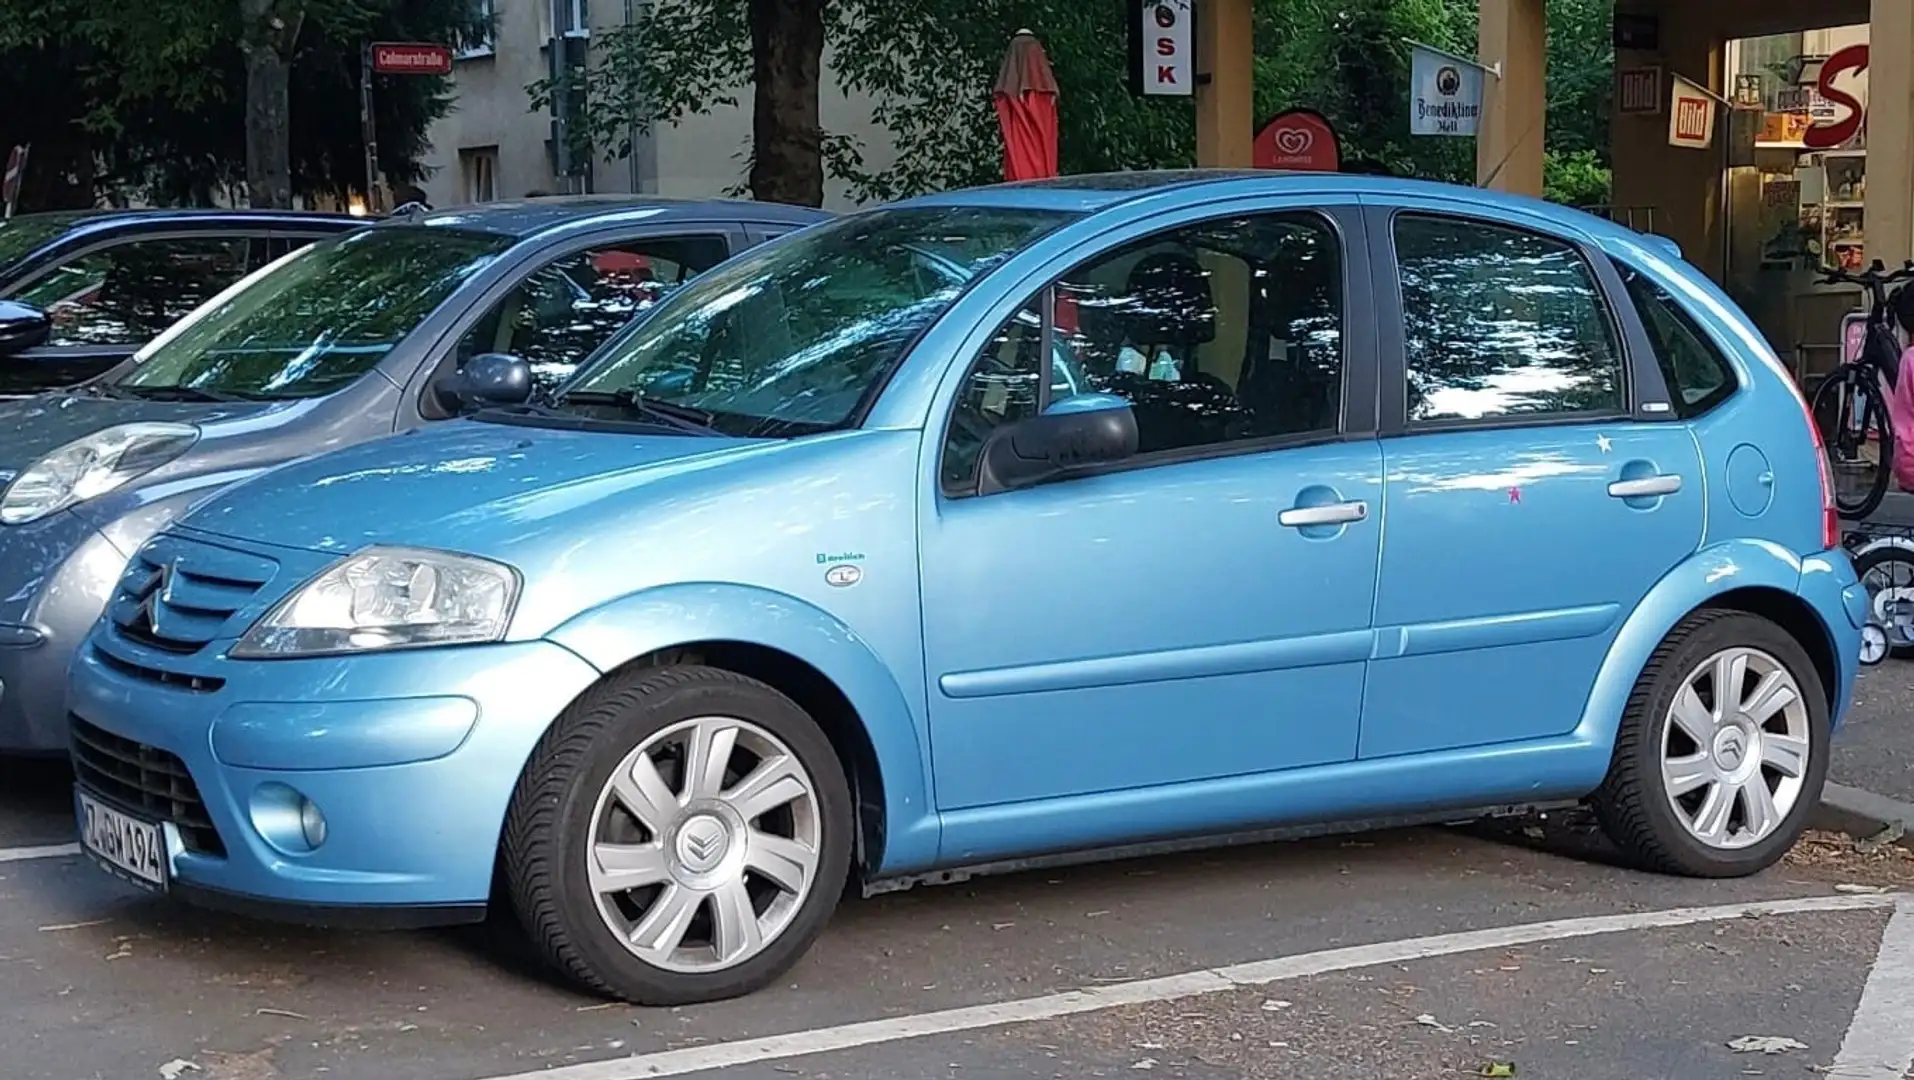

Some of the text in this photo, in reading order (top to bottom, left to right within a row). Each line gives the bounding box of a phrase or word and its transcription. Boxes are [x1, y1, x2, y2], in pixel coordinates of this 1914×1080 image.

[1623, 72, 1654, 109] Bild
[1678, 101, 1706, 136] Bild
[126, 822, 159, 878] 194
